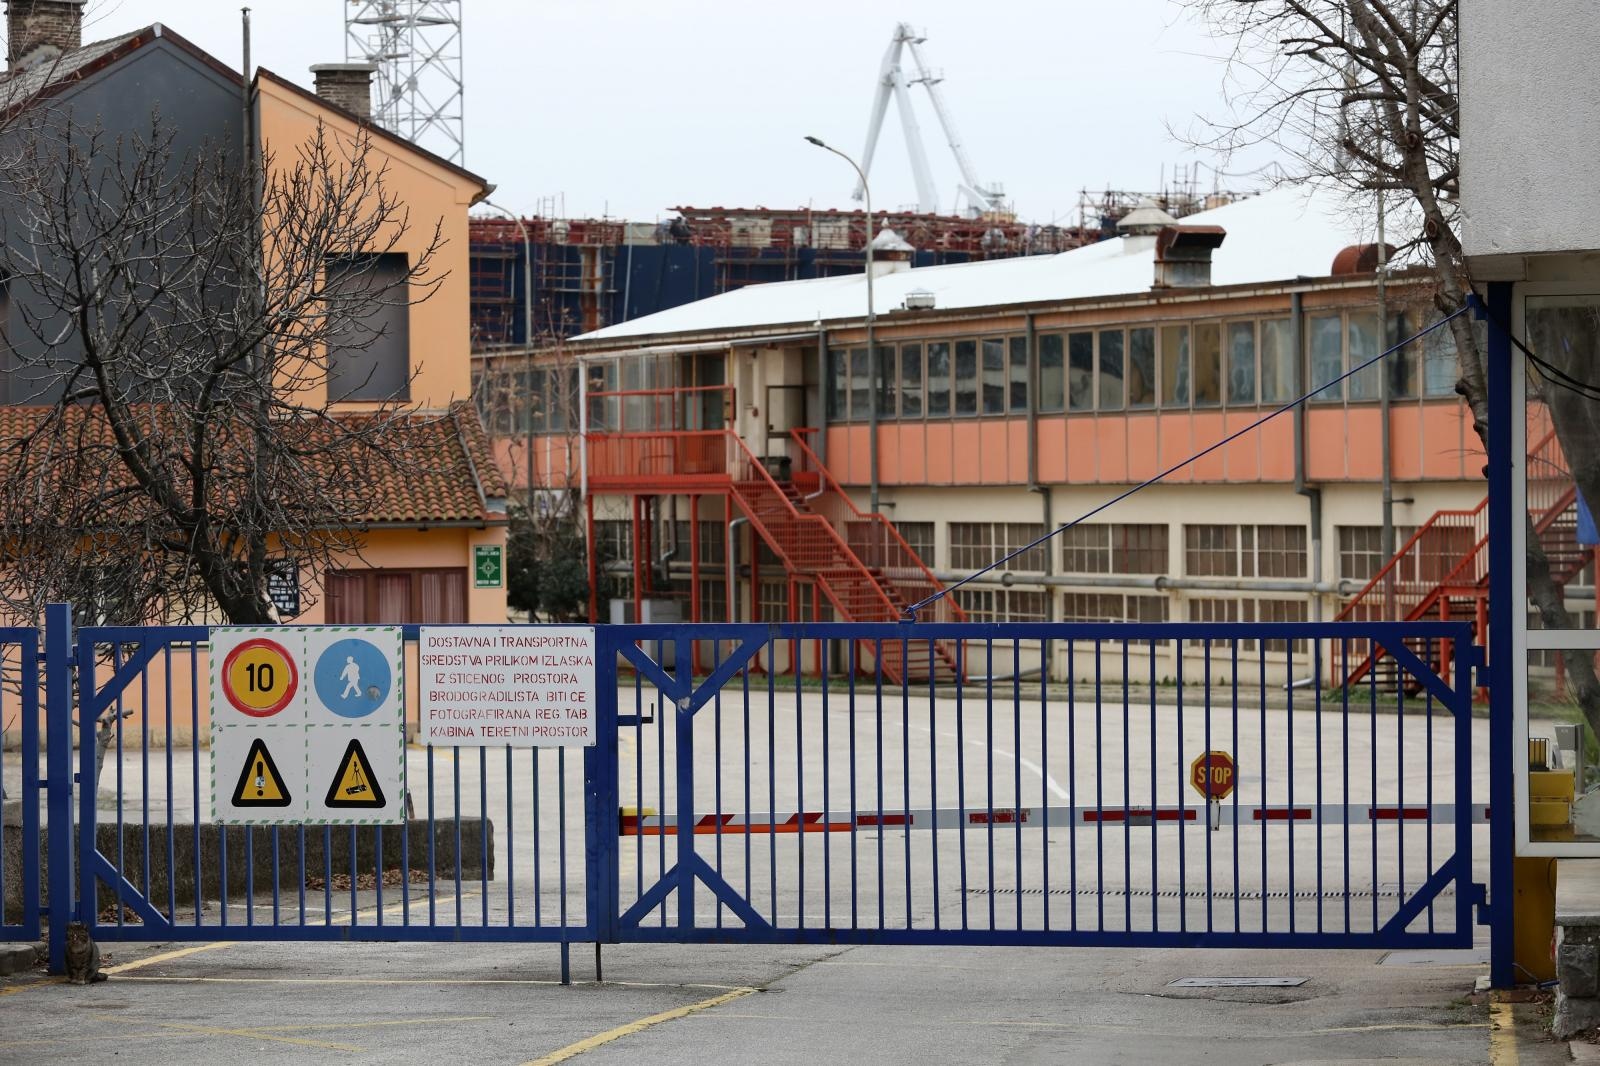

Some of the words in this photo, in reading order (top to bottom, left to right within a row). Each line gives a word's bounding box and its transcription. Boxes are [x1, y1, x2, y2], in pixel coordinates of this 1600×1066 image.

[428, 636, 491, 648] DOSTAVNA
[493, 636, 497, 648] I
[500, 636, 588, 648] TRANSPORTNA
[422, 654, 483, 667] SREDSTVA
[485, 655, 539, 667] PRILIKOM
[541, 655, 593, 667] IZLASKA
[245, 663, 274, 692] 10
[435, 673, 446, 684] IZ
[449, 673, 505, 684] STICENOG
[513, 673, 578, 684] PROSTORA
[429, 691, 540, 702] BRODOGRADILISTA
[546, 691, 567, 702] BITI
[570, 691, 586, 702] CE
[429, 708, 531, 720] FOTOGRAFIRANA
[430, 726, 475, 738] KABINA
[480, 726, 529, 738] TERETNI
[532, 726, 588, 738] PROSTOR
